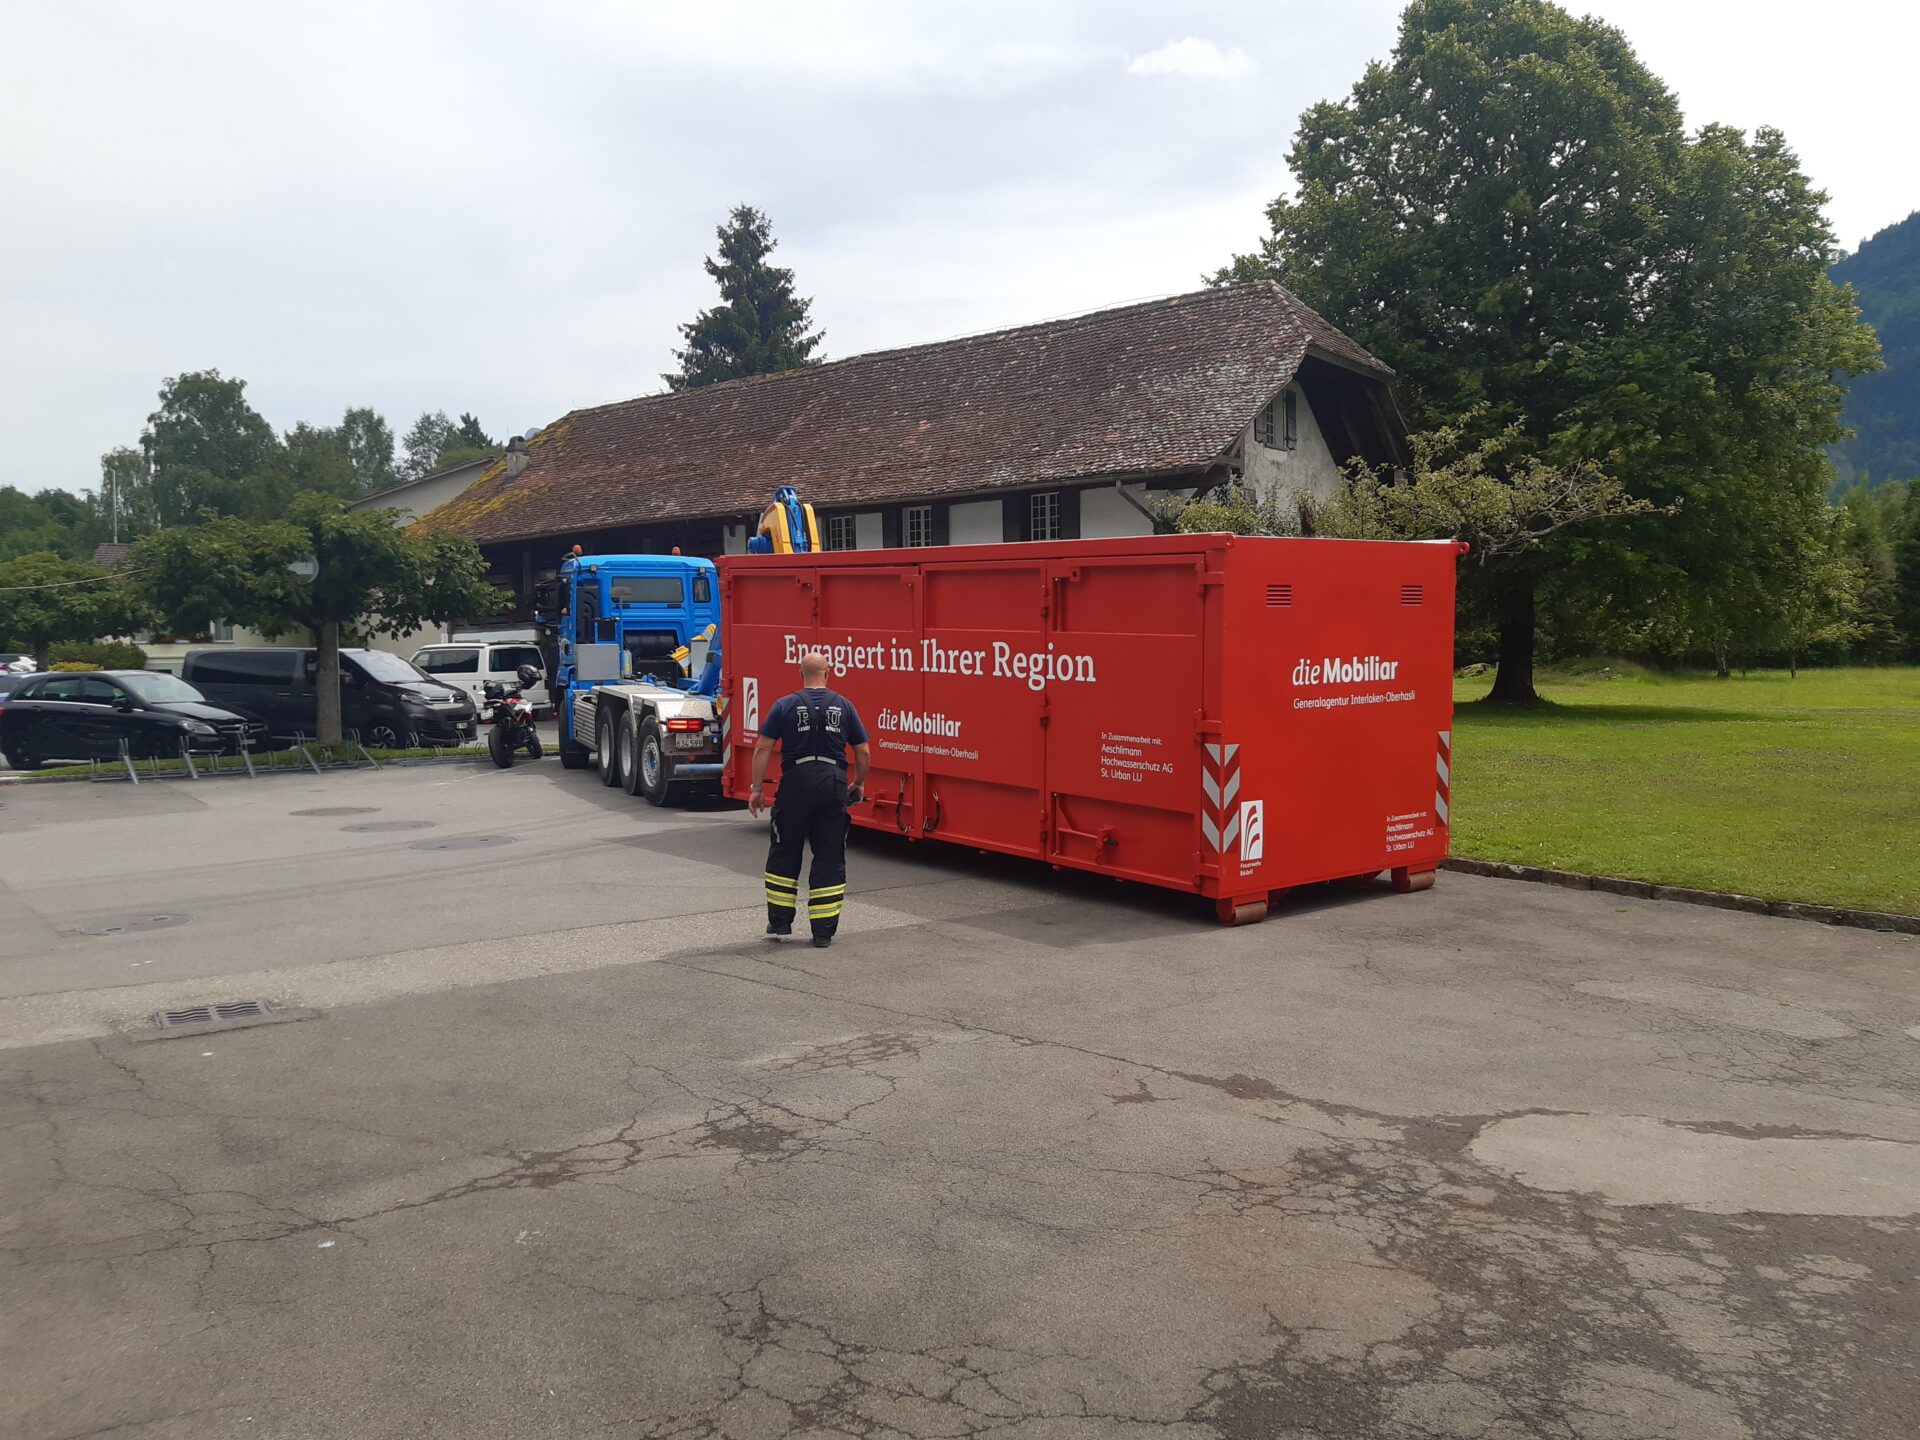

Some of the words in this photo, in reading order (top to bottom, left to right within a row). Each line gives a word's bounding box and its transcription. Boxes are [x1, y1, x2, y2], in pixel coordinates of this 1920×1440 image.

[784, 634, 885, 678] Enagiert
[890, 637, 914, 672] in
[920, 638, 986, 676] Ihrer
[992, 641, 1096, 691] Region
[1292, 658, 1321, 686] die
[1322, 655, 1399, 684] Mobiliar
[1293, 697, 1350, 710] Generalagentur
[1350, 690, 1416, 705] Interlaken-Oberhasli
[877, 708, 898, 731] die
[899, 710, 961, 738] Mobiliar
[1101, 731, 1108, 740] In
[1108, 732, 1151, 745] Zusammenarbeit
[878, 738, 920, 753] Generalagentur
[920, 744, 979, 760] Interlaken-Oberhasli
[1101, 743, 1142, 757] Aeschlimann
[1101, 755, 1161, 772] Hochwasserschutz
[1161, 763, 1174, 773] AG
[1100, 767, 1110, 778] St.
[1110, 769, 1132, 781] Urban
[1132, 772, 1143, 782] LU
[1426, 827, 1434, 836] AG
